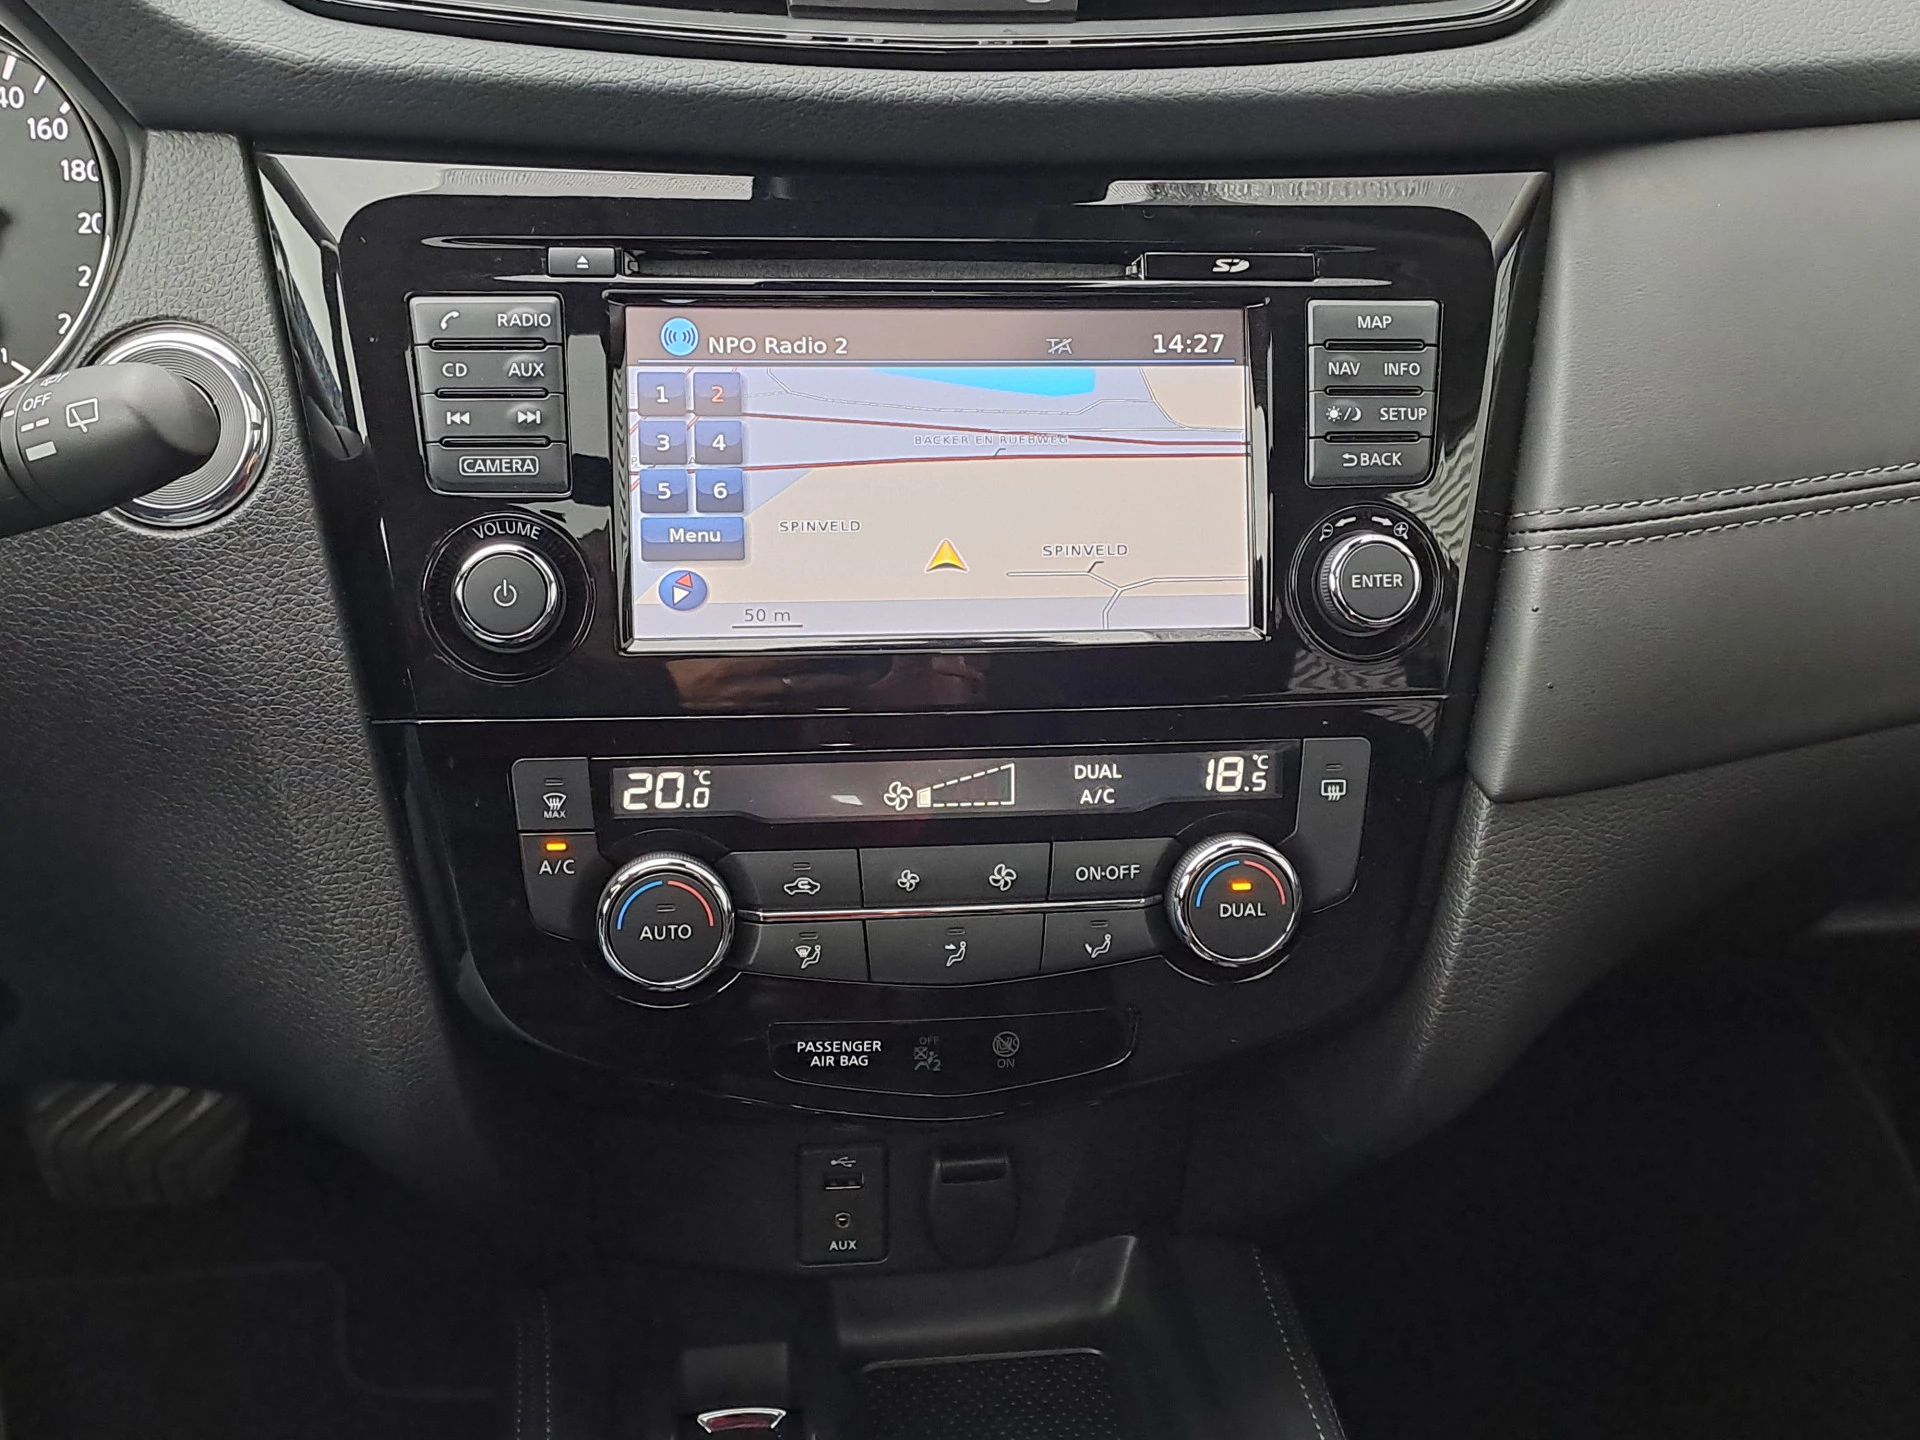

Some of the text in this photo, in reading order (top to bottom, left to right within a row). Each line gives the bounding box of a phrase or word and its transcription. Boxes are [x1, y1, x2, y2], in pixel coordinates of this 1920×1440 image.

[27, 117, 69, 140] 160
[60, 159, 99, 182] 180
[1212, 258, 1250, 273] SD
[497, 312, 551, 328] RADIO
[1357, 315, 1392, 330] MAP
[708, 336, 848, 354] NPO Radio 2
[1152, 334, 1225, 354] 14:27
[442, 362, 468, 378] CD
[508, 362, 545, 377] AUX
[1328, 362, 1361, 377] NAV
[1384, 362, 1421, 377] INFO
[22, 391, 52, 412] OFF
[656, 385, 669, 403] 1
[711, 386, 724, 403] 2
[1380, 407, 1428, 422] SETUP
[656, 434, 670, 452] 3
[712, 434, 727, 452] 4
[914, 434, 970, 446] BACKER
[975, 434, 995, 445] EN
[464, 458, 536, 473] CAMERA
[1361, 452, 1403, 467] BACK
[657, 482, 671, 500] 5
[713, 482, 728, 500] 6
[472, 521, 541, 540] VOLUME
[779, 519, 862, 533] SPINVELD
[669, 527, 721, 543] Menu
[1042, 544, 1129, 557] SPINVELD
[1352, 573, 1403, 588] ENTER
[744, 607, 791, 623] 50 m
[1074, 764, 1122, 779] DUAL
[1205, 757, 1267, 793] 18.5
[622, 772, 710, 811] 20.0
[1080, 788, 1116, 805] A/C
[543, 810, 567, 819] MAX
[539, 859, 576, 876] A/C
[1219, 903, 1267, 918] DUAL
[639, 925, 692, 942] AUTO
[797, 1040, 882, 1054] PASSENGER
[919, 1036, 940, 1046] OFF
[810, 1055, 869, 1068] AIR BAG
[997, 1058, 1015, 1069] ON
[829, 1239, 857, 1252] AUX
